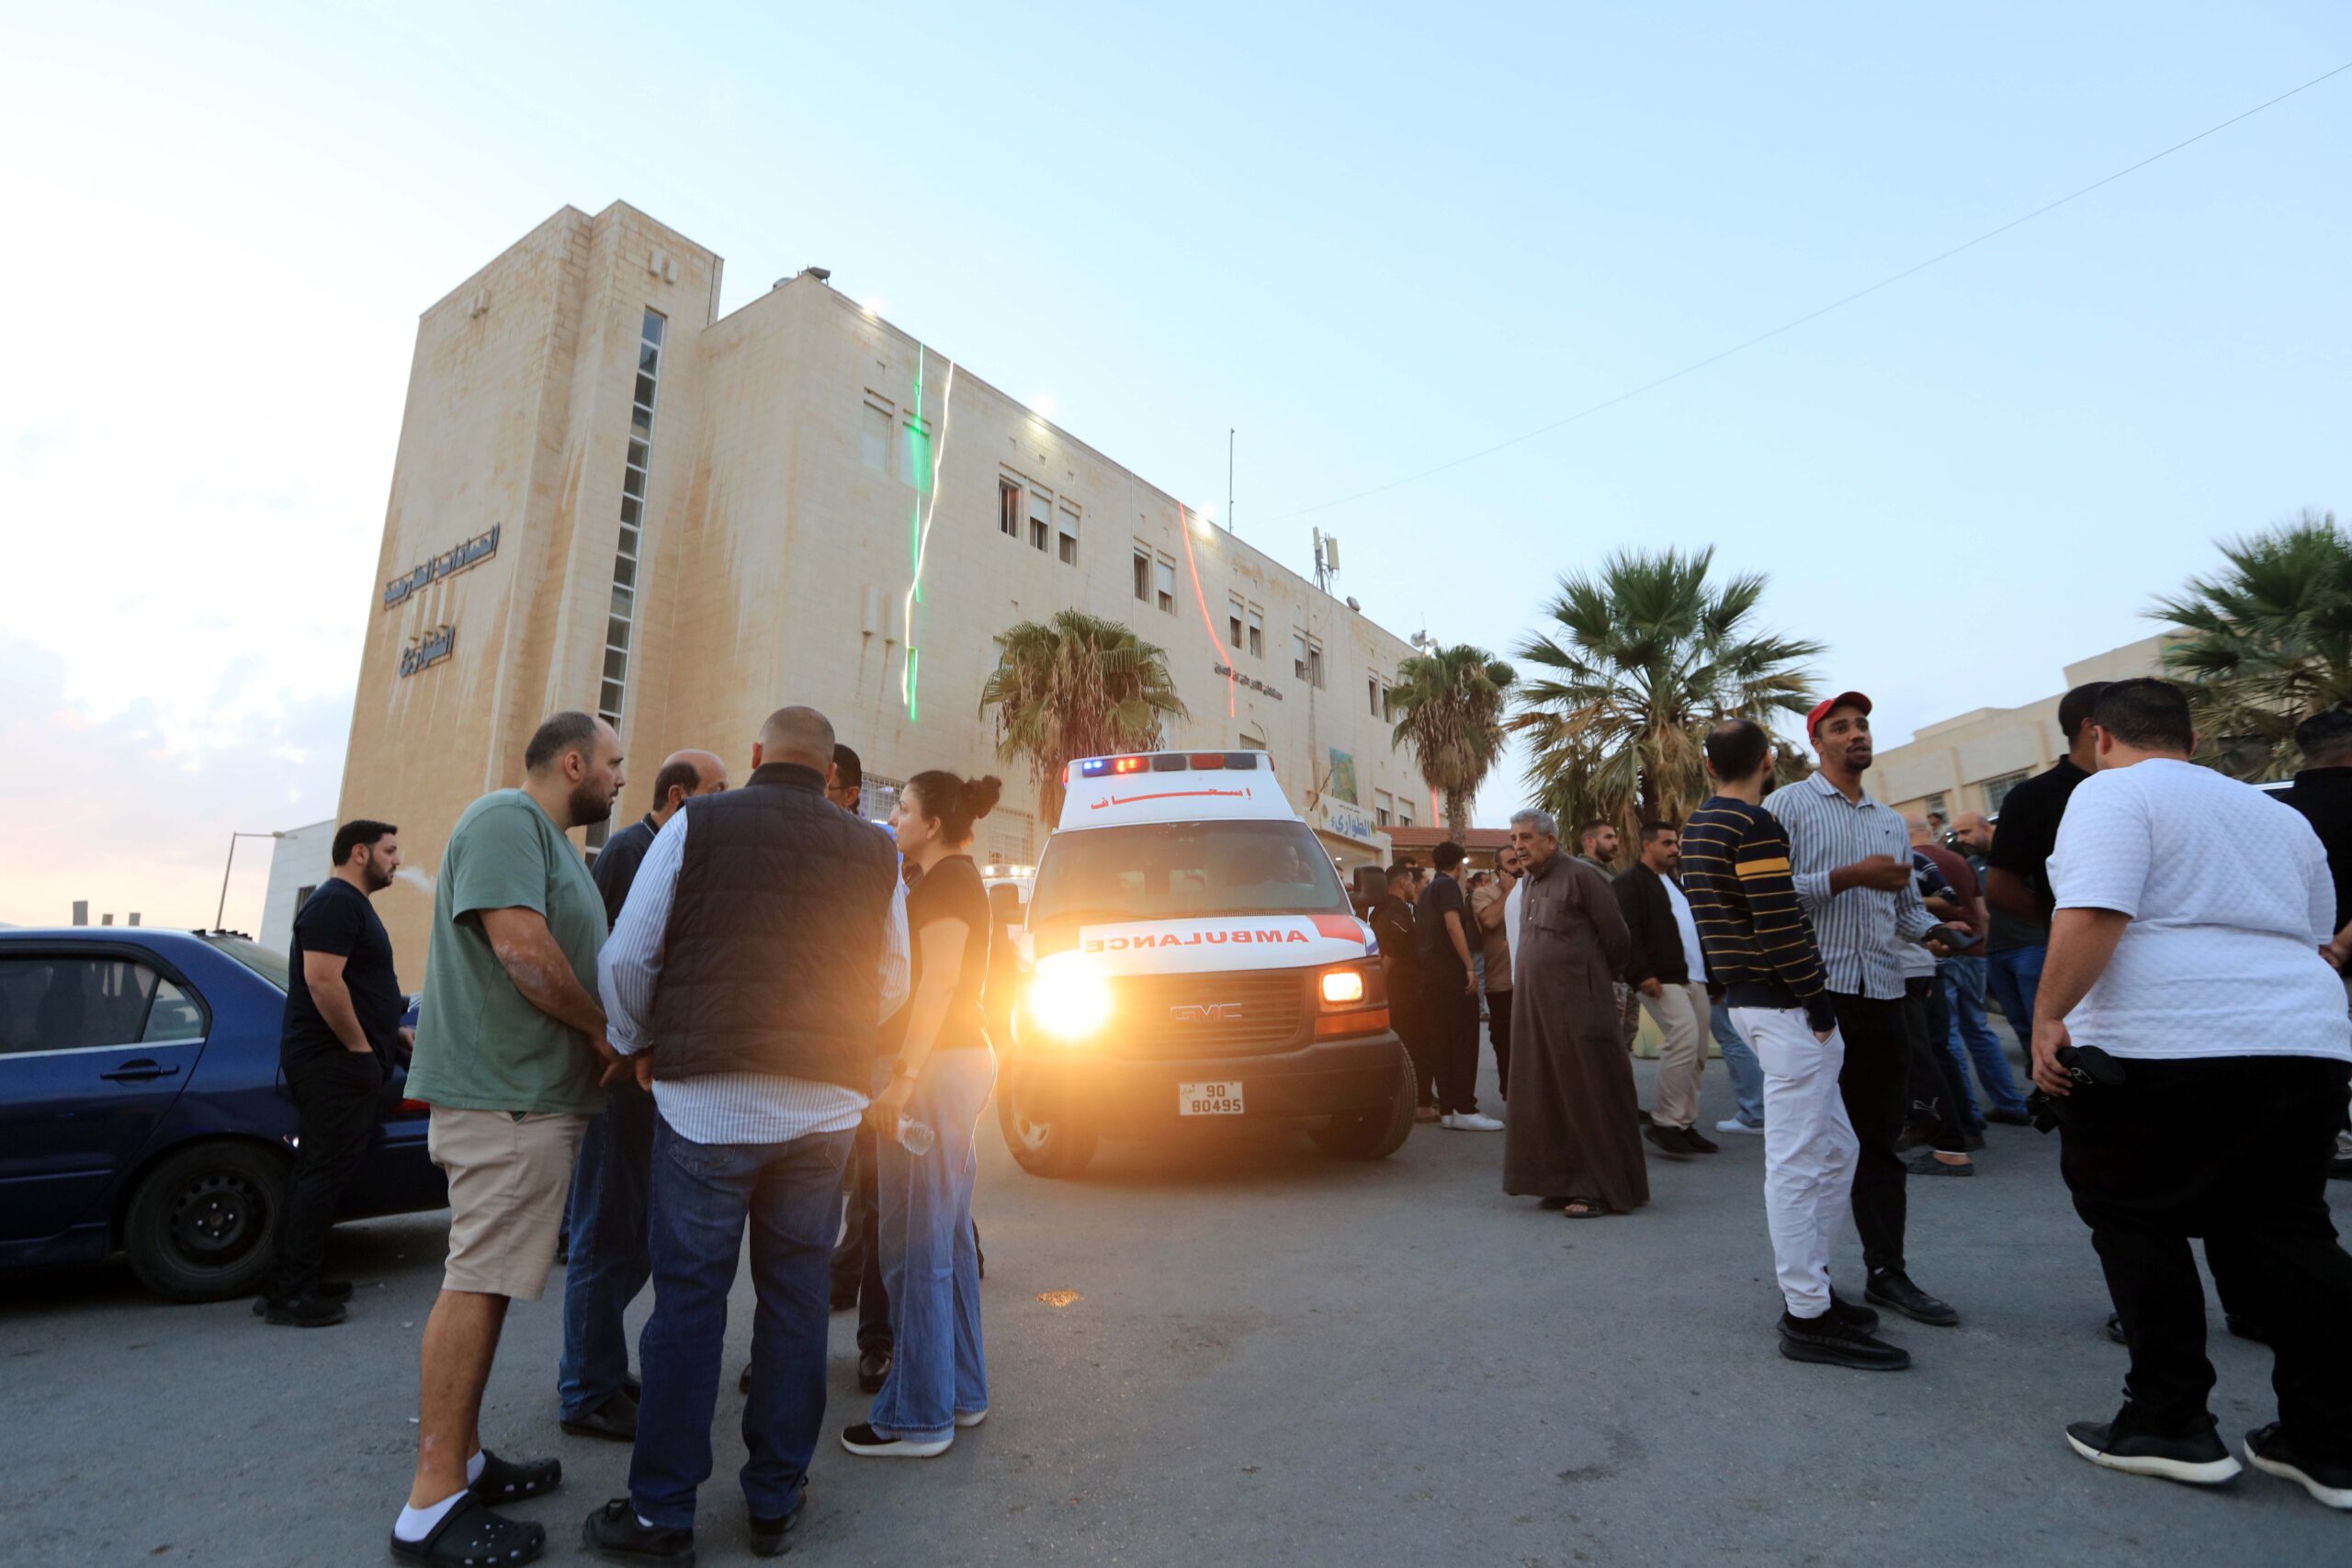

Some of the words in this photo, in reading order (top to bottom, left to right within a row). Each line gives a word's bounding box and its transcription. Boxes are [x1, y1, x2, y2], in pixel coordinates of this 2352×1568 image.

[1091, 787, 1252, 809] إسعاف
[1170, 1003, 1242, 1021] GMC
[1206, 1085, 1226, 1098] 90
[1192, 1099, 1241, 1112] 80495
